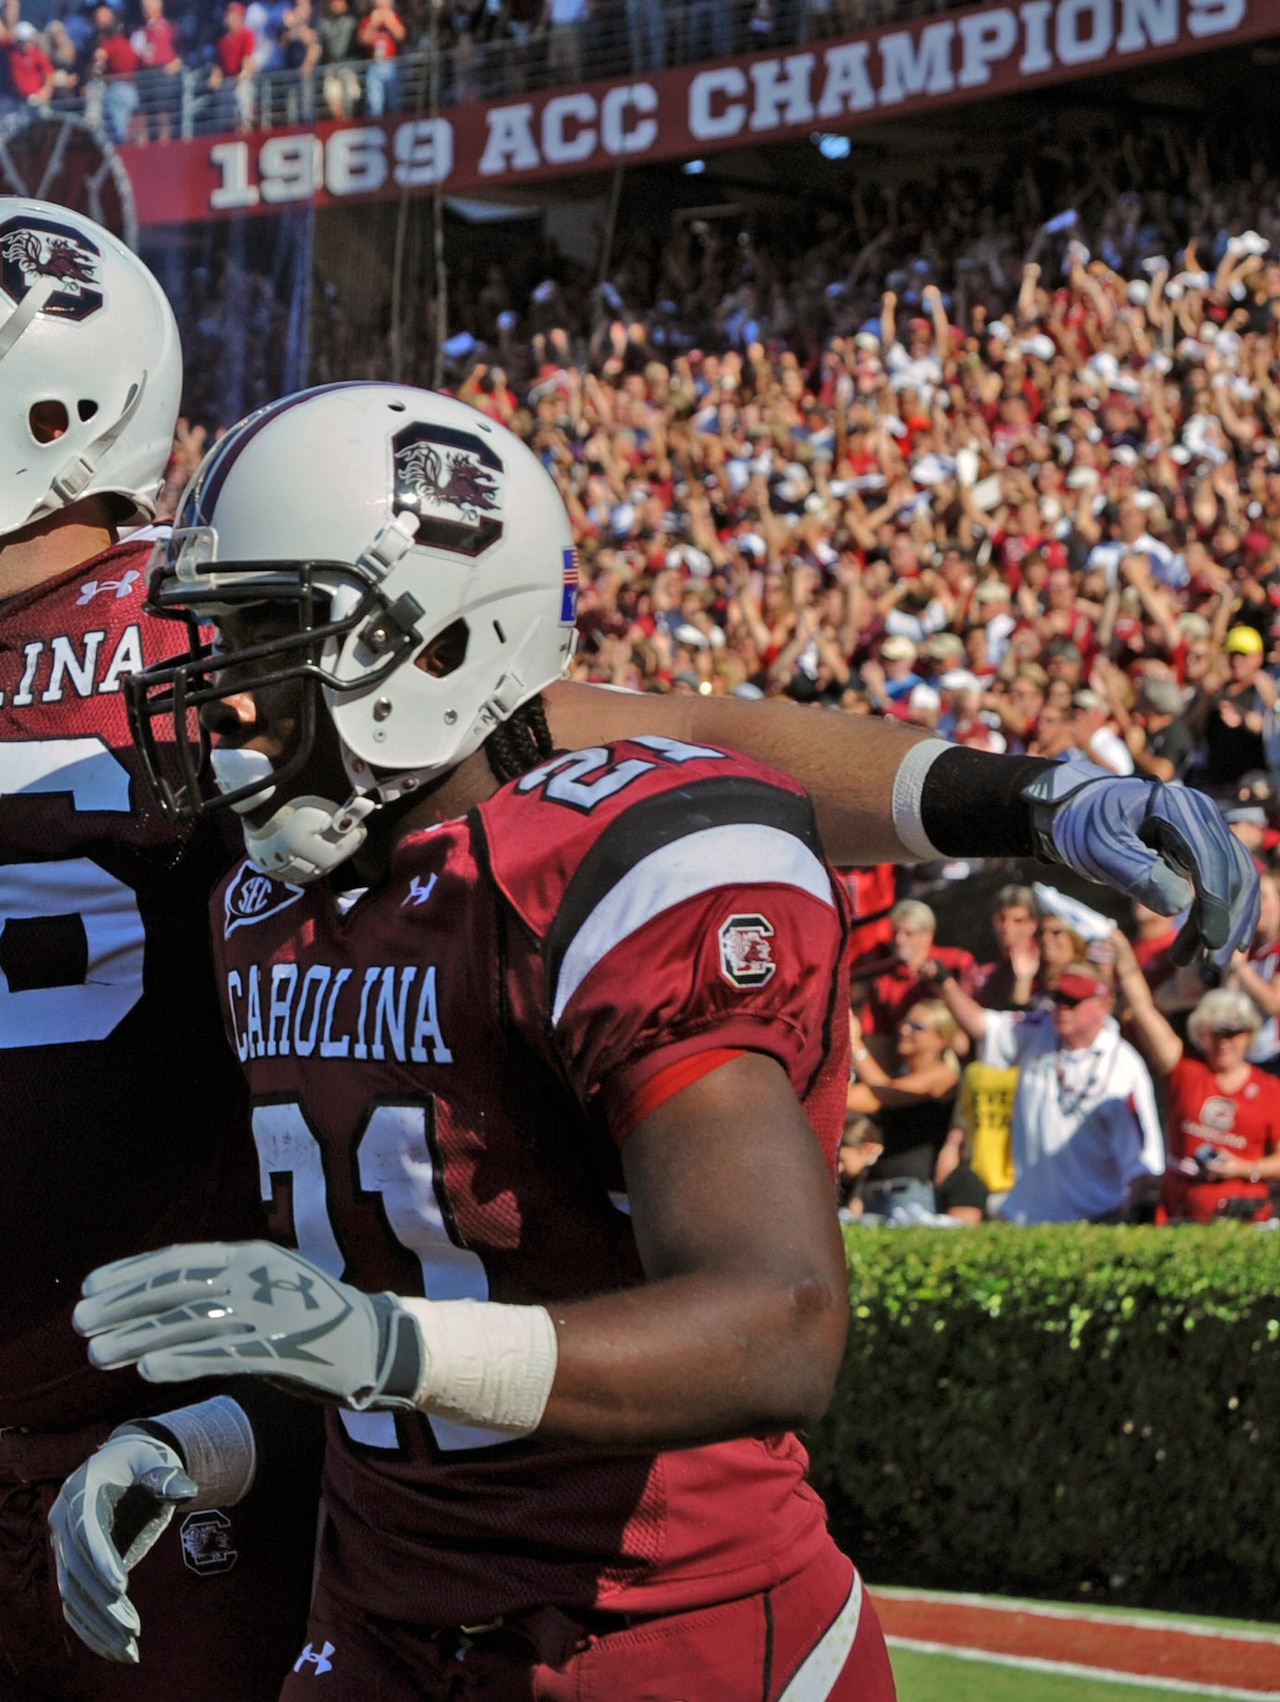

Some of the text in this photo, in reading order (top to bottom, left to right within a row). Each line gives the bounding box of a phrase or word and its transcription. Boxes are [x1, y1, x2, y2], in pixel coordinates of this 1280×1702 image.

[210, 0, 1248, 209] 1969 ACC CHAMPIONS
[238, 876, 272, 913] SEC
[227, 963, 454, 1063] CAROLINA
